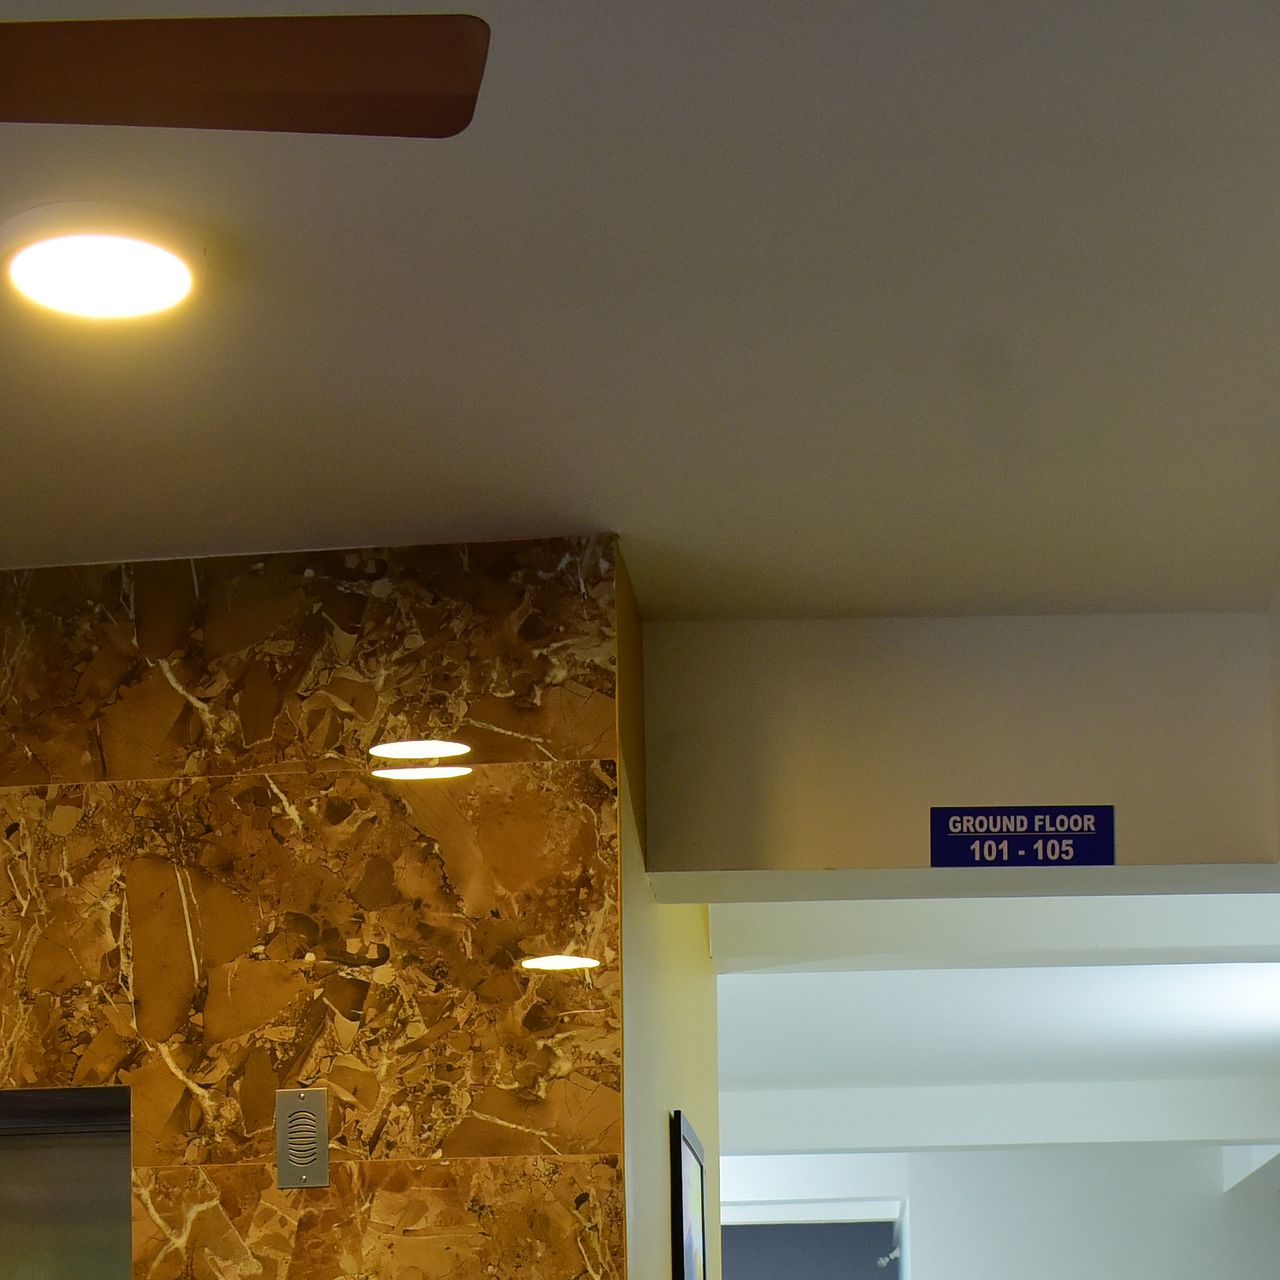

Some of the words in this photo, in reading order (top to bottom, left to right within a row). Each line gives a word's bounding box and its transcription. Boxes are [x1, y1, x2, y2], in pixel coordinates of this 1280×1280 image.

[948, 815, 1028, 833] GROUND
[1034, 814, 1096, 832] FLOOR
[970, 839, 1009, 861] 101
[1033, 839, 1074, 861] 105
